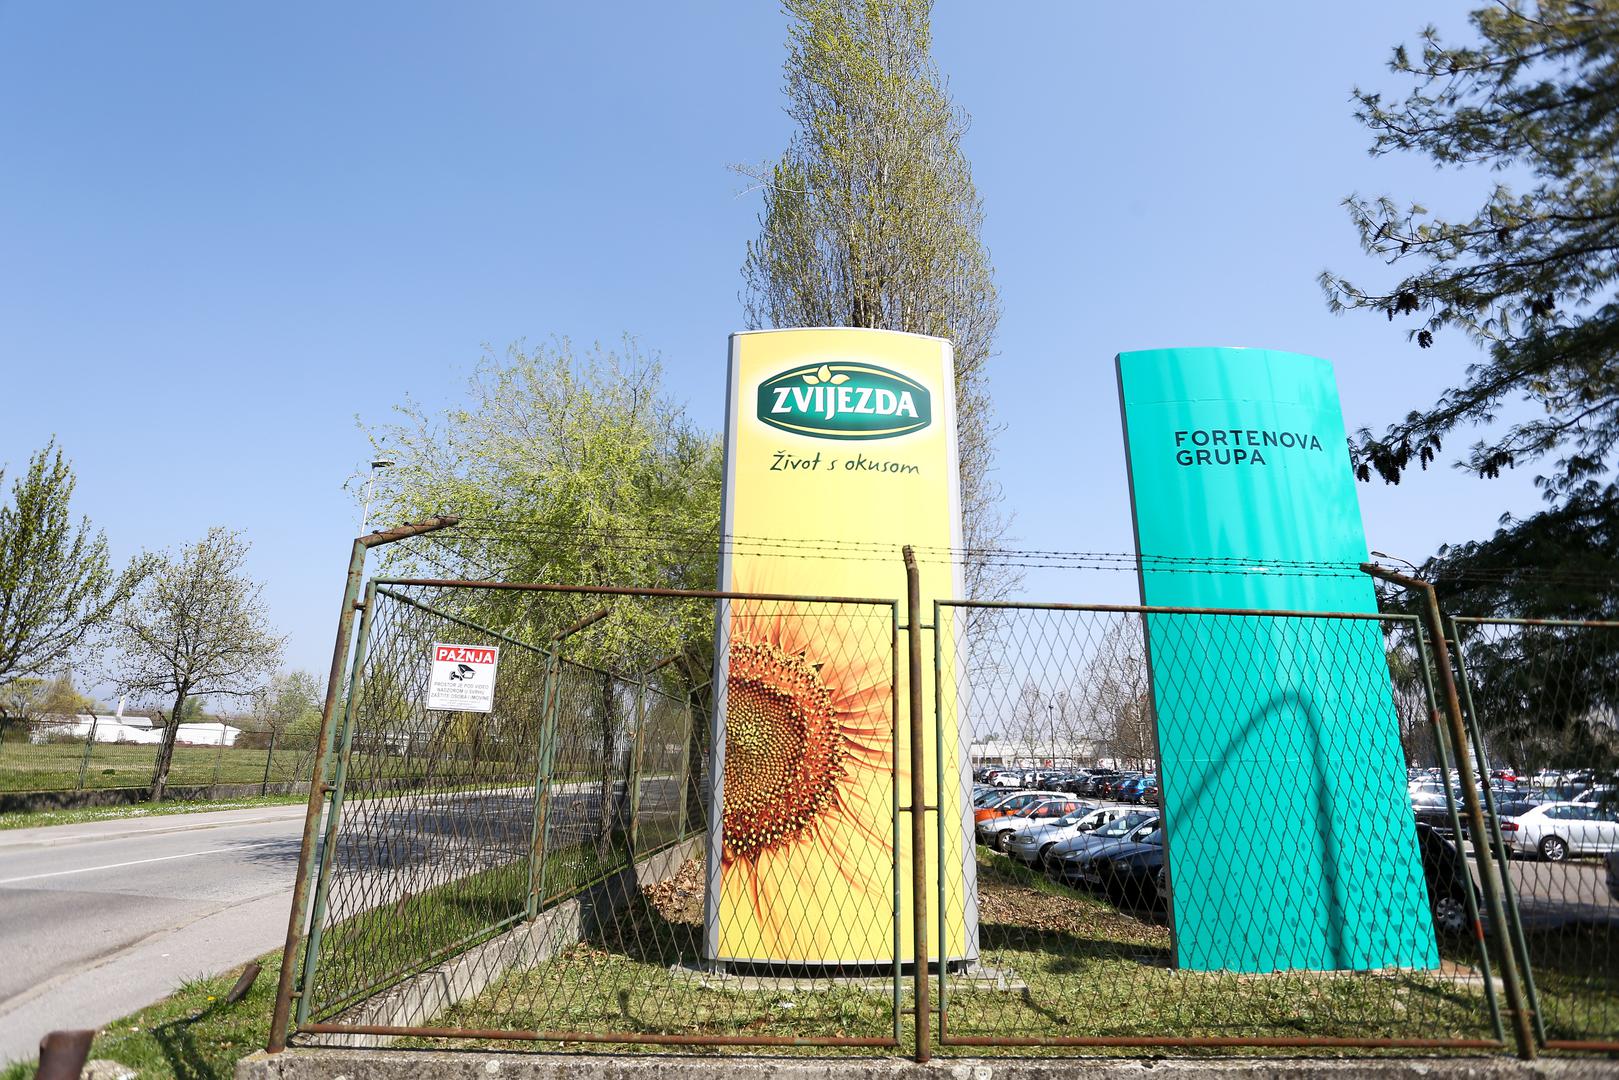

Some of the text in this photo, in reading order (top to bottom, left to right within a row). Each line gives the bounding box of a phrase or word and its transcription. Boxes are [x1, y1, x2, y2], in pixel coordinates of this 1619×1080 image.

[771, 386, 919, 420] ZVIJEZDA
[1175, 430, 1323, 451] FORTENOVA
[770, 449, 920, 475] Život s okusom
[1176, 448, 1266, 466] GRUPA
[438, 648, 493, 663] PAŽNJA
